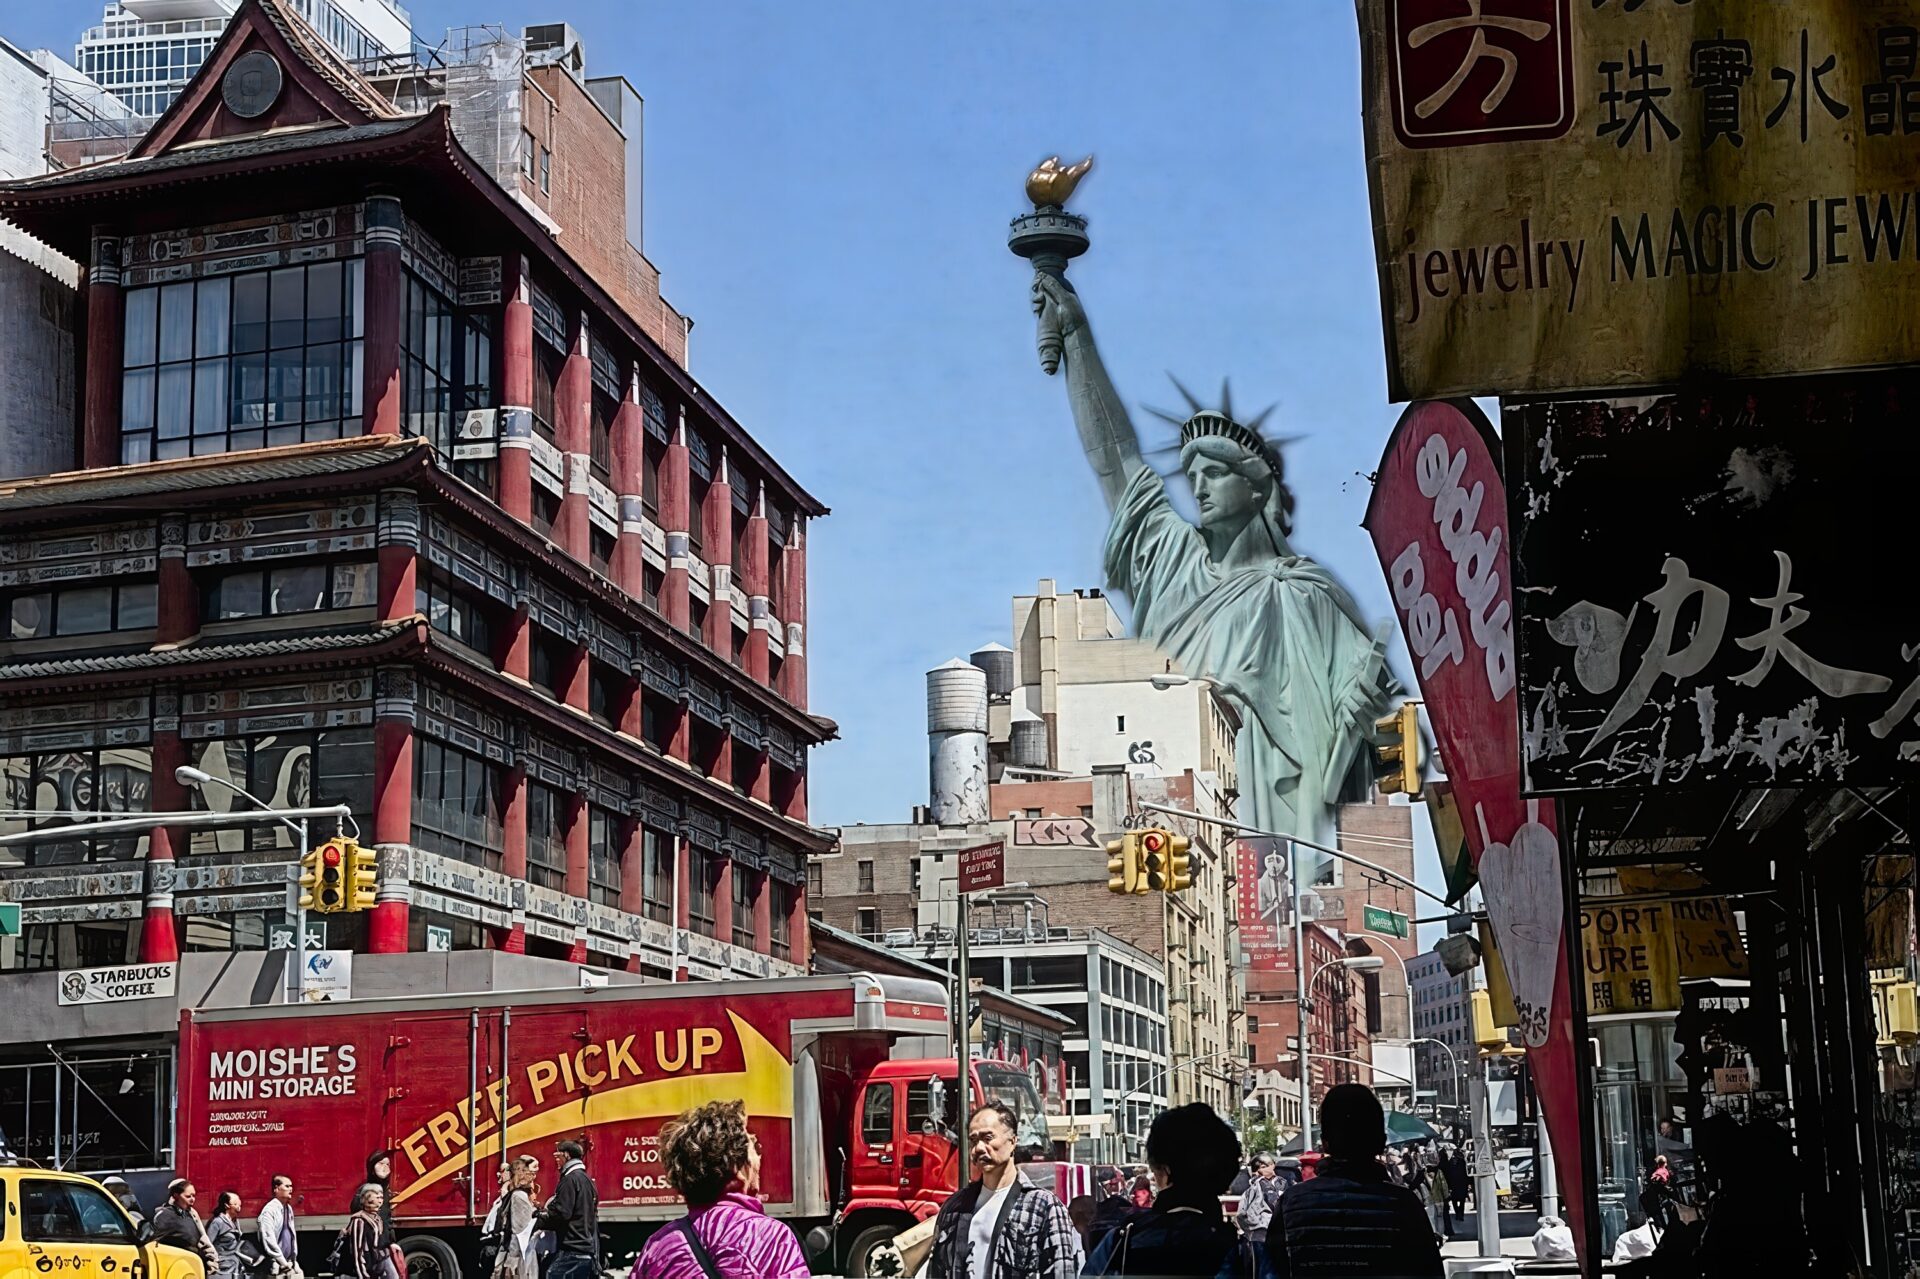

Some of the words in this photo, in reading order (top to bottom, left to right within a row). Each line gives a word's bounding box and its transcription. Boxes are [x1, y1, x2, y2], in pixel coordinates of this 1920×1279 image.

[1405, 218, 1586, 324] jewelry
[1609, 202, 1777, 282] MAGIC
[90, 965, 171, 984] STARBUCKS
[106, 982, 155, 998] COFFEE
[209, 1079, 254, 1101] MINI
[259, 1075, 356, 1098] STORAGE
[401, 1074, 523, 1177] FREE
[526, 1034, 644, 1105] PICK
[655, 1027, 723, 1073] UP
[622, 1150, 639, 1163] AS
[641, 1149, 662, 1163] LO
